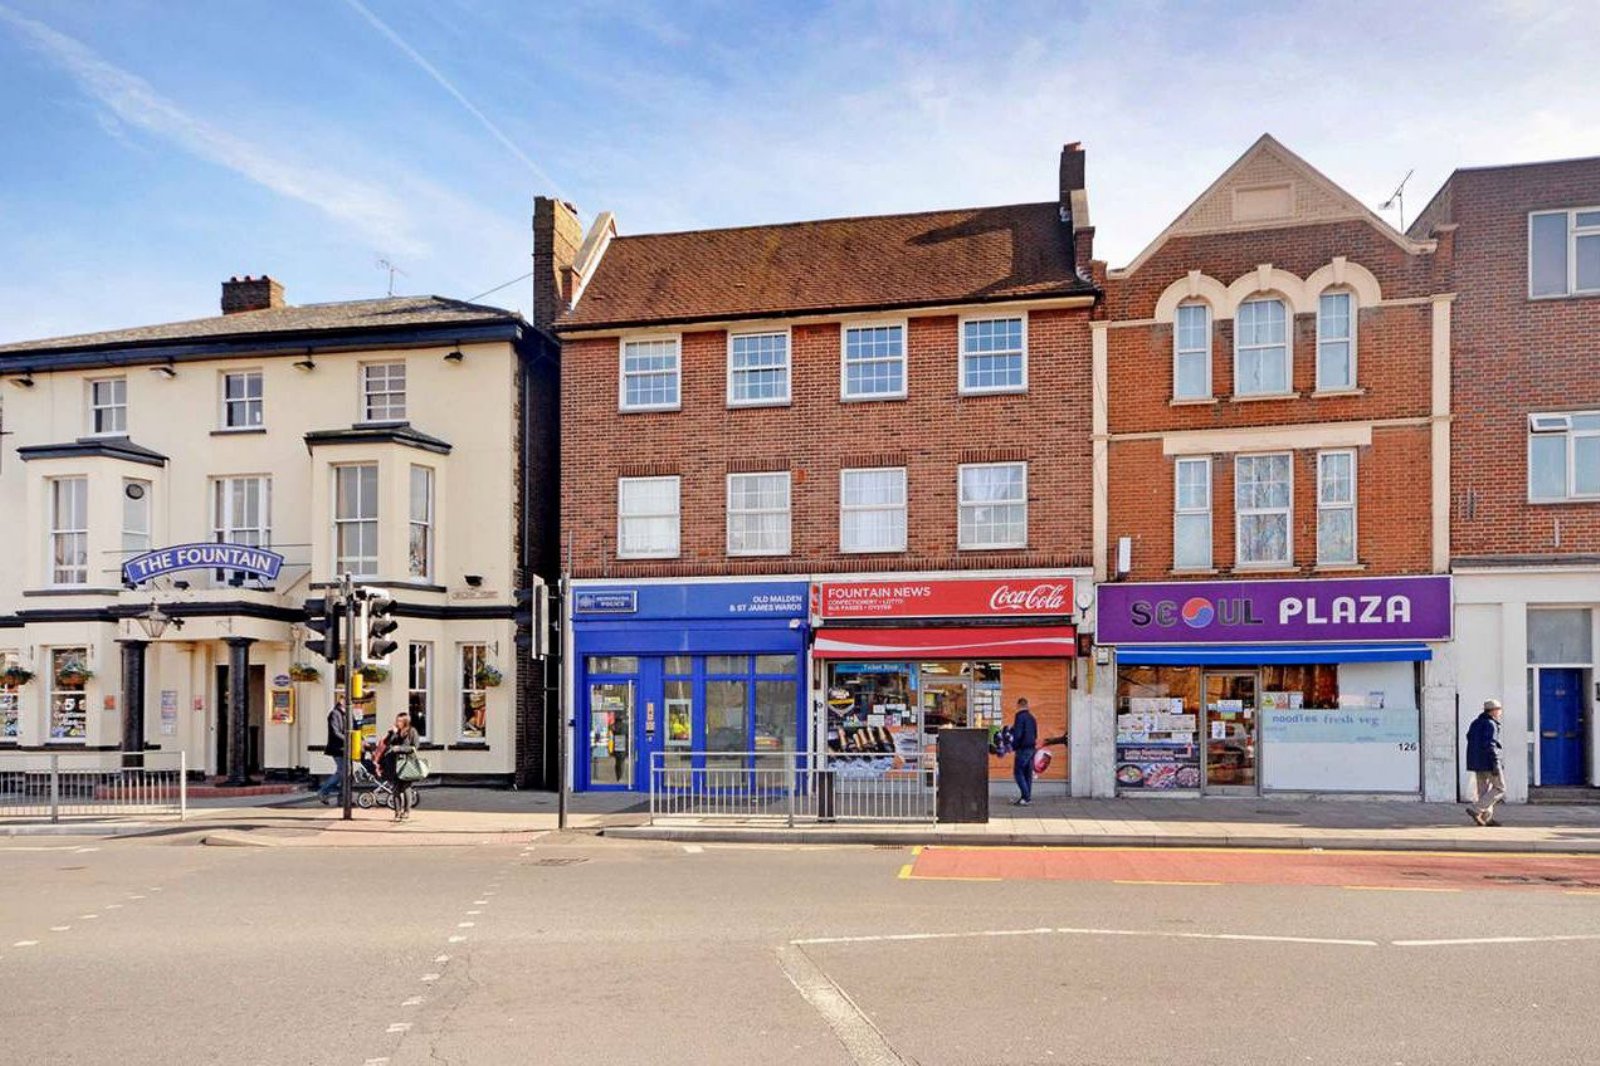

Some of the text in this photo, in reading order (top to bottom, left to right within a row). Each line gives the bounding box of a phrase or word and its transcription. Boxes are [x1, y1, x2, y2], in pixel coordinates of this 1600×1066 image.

[135, 548, 271, 575] THE FOUNTAIN
[828, 586, 931, 598] FOUNTAIN NEWS
[753, 594, 802, 603] OLD MALDEN
[737, 604, 747, 612] ST
[748, 603, 773, 612] JAMES
[774, 603, 802, 611] WARDS
[1279, 595, 1411, 625] PLAZA
[1272, 714, 1380, 727] noodles fresh veg
[1398, 742, 1417, 751] 126
